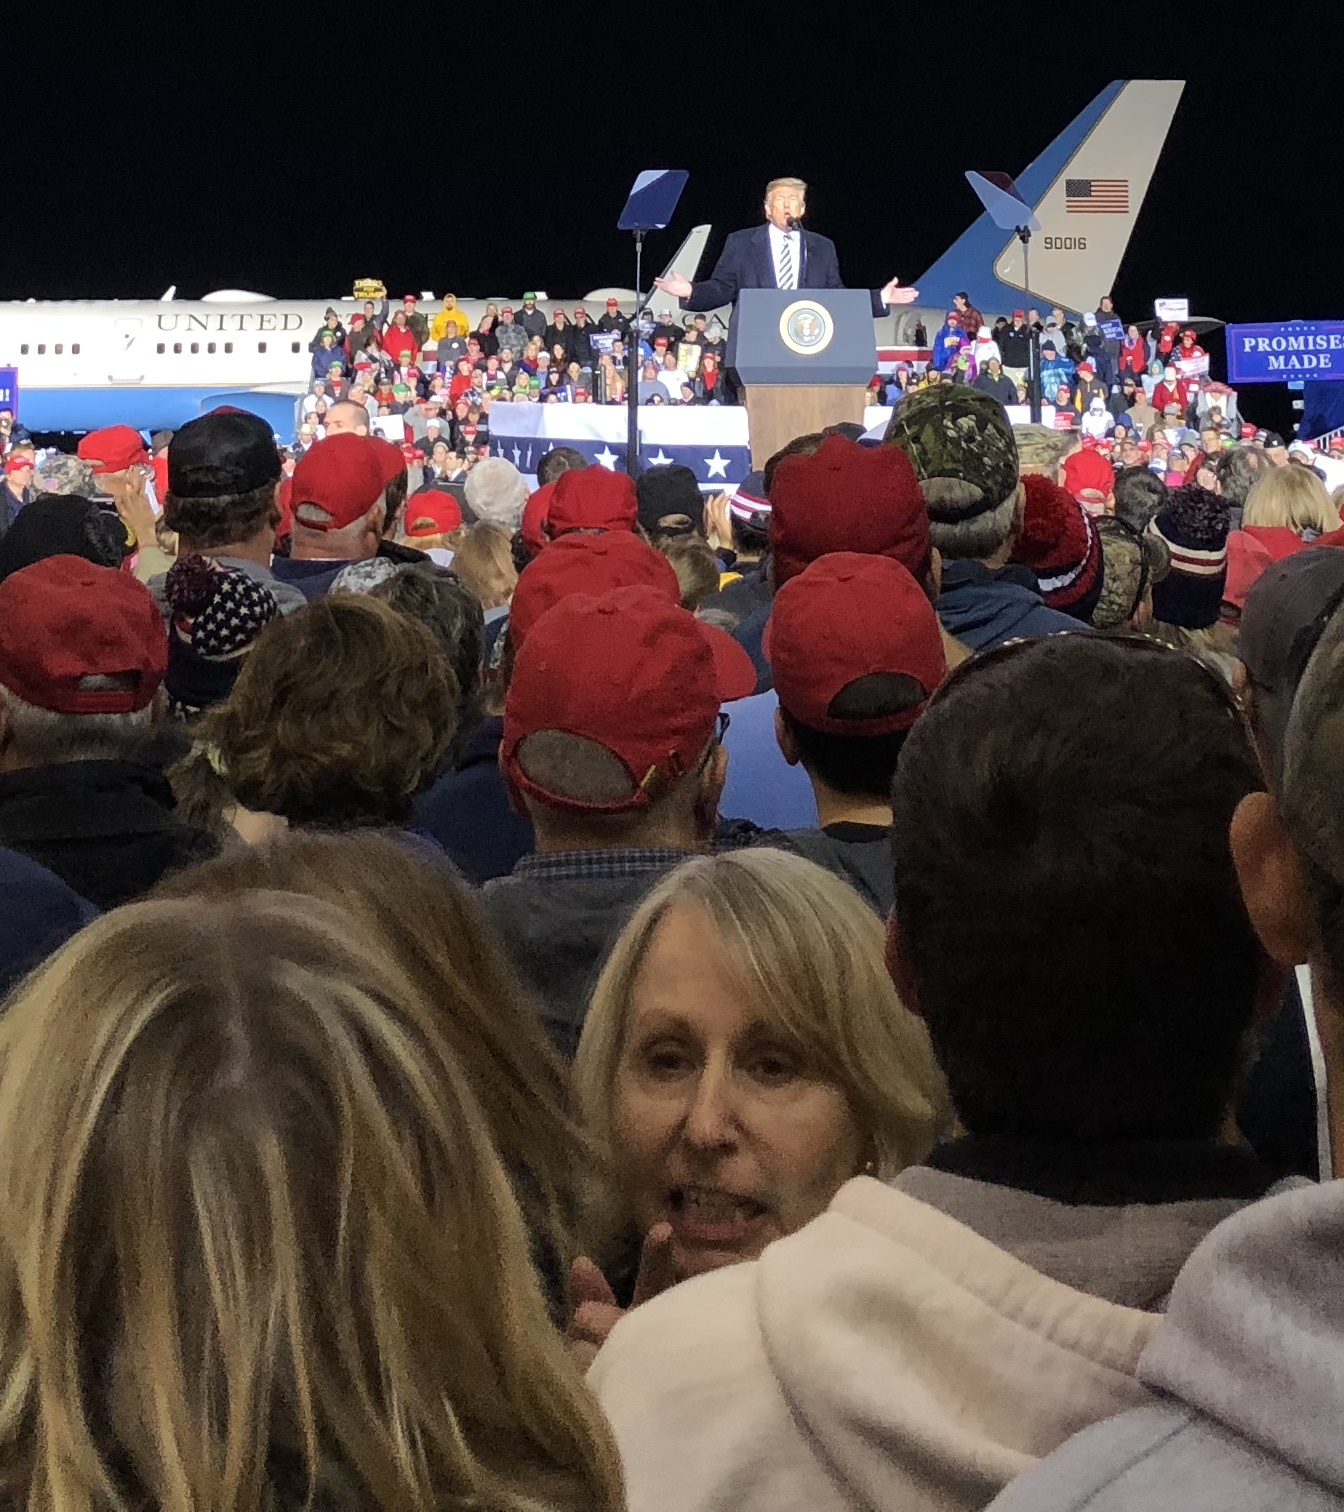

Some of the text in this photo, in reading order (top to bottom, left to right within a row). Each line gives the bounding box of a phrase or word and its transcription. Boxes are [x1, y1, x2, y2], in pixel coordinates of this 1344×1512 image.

[1044, 237, 1087, 250] 90016
[157, 314, 304, 332] UNITED
[1267, 353, 1332, 370] MADE
